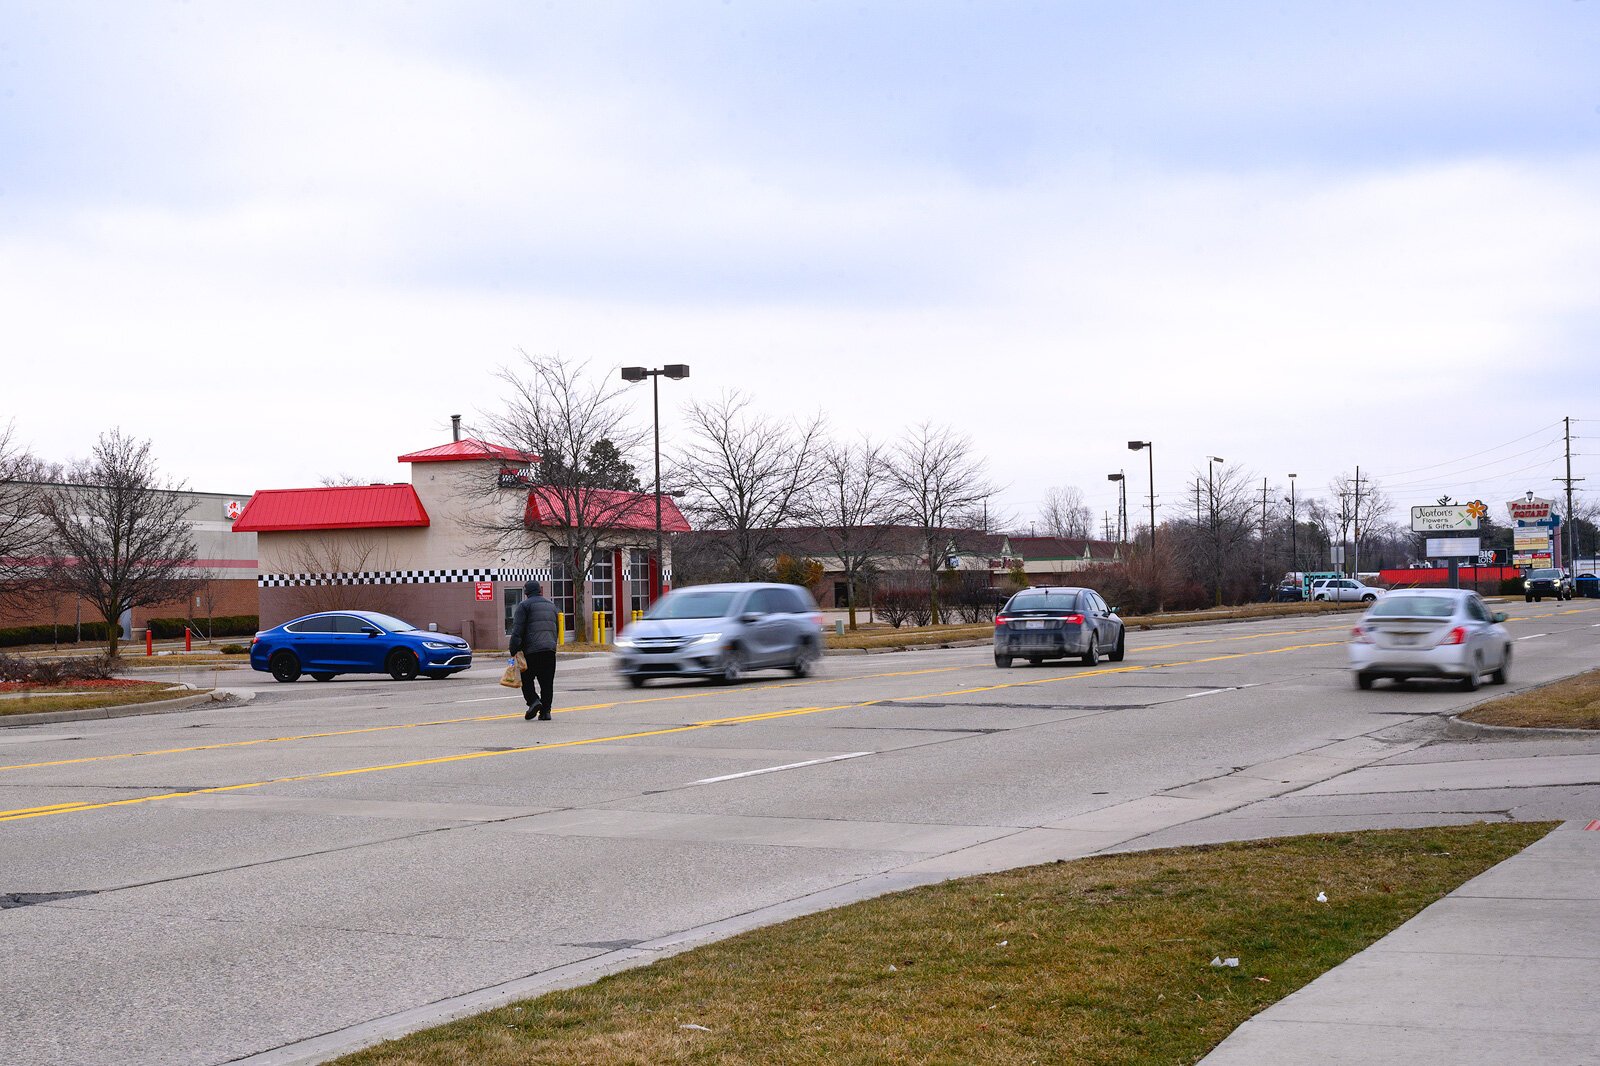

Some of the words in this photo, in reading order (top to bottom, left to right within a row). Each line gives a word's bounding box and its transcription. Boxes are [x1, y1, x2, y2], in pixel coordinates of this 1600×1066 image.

[1415, 507, 1453, 519] Norton's
[1513, 510, 1549, 518] SQUARE
[1478, 550, 1495, 558] BIG
